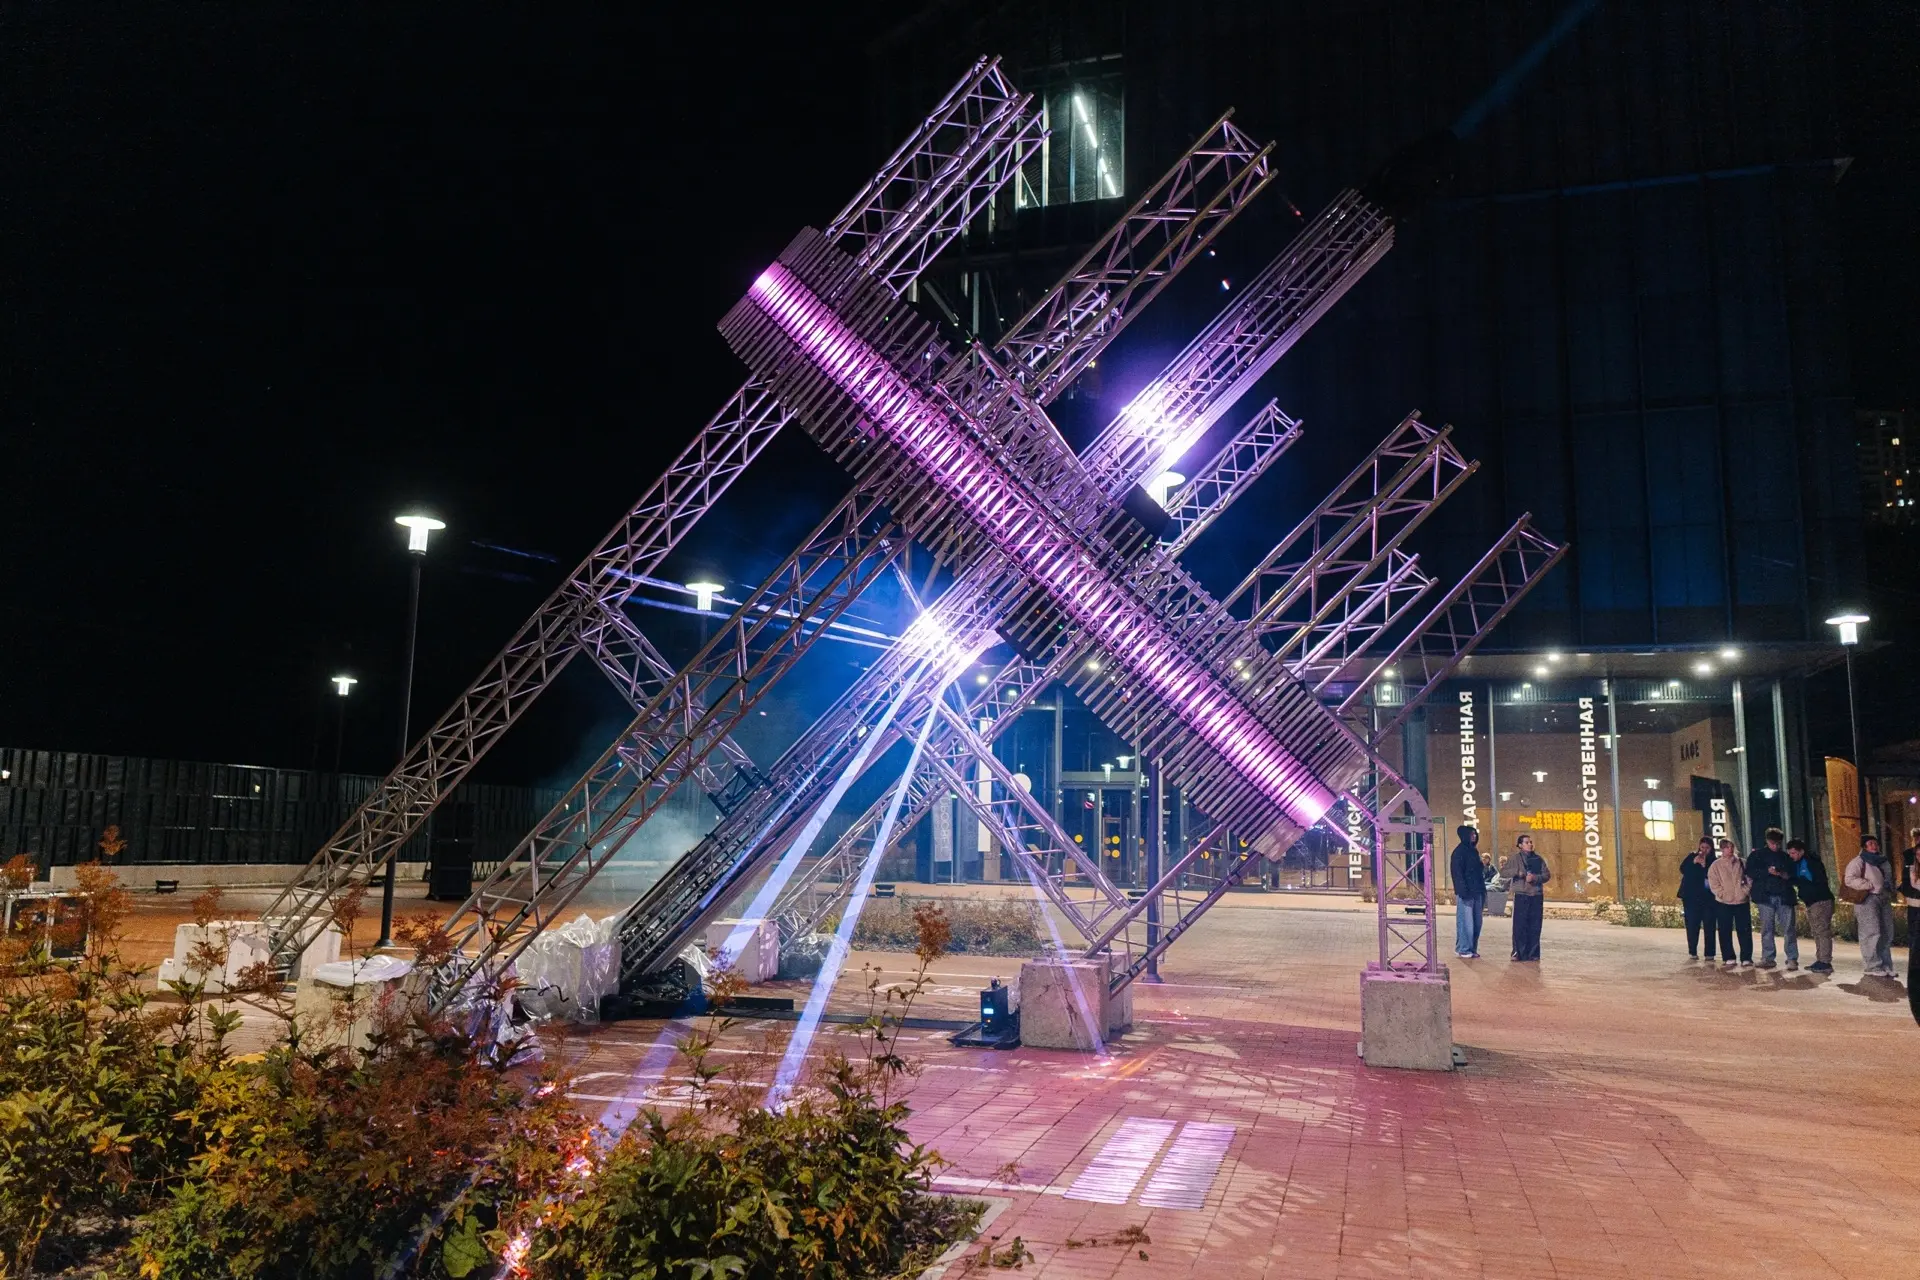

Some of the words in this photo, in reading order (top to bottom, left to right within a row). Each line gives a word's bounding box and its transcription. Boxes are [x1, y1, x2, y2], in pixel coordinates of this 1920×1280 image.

[1347, 780, 1363, 879] ПЕРМСК
[1459, 691, 1480, 834] ДАРСТВЕННАЯ
[1579, 697, 1603, 885] ХУДОЖЕСТВЕННАЯ
